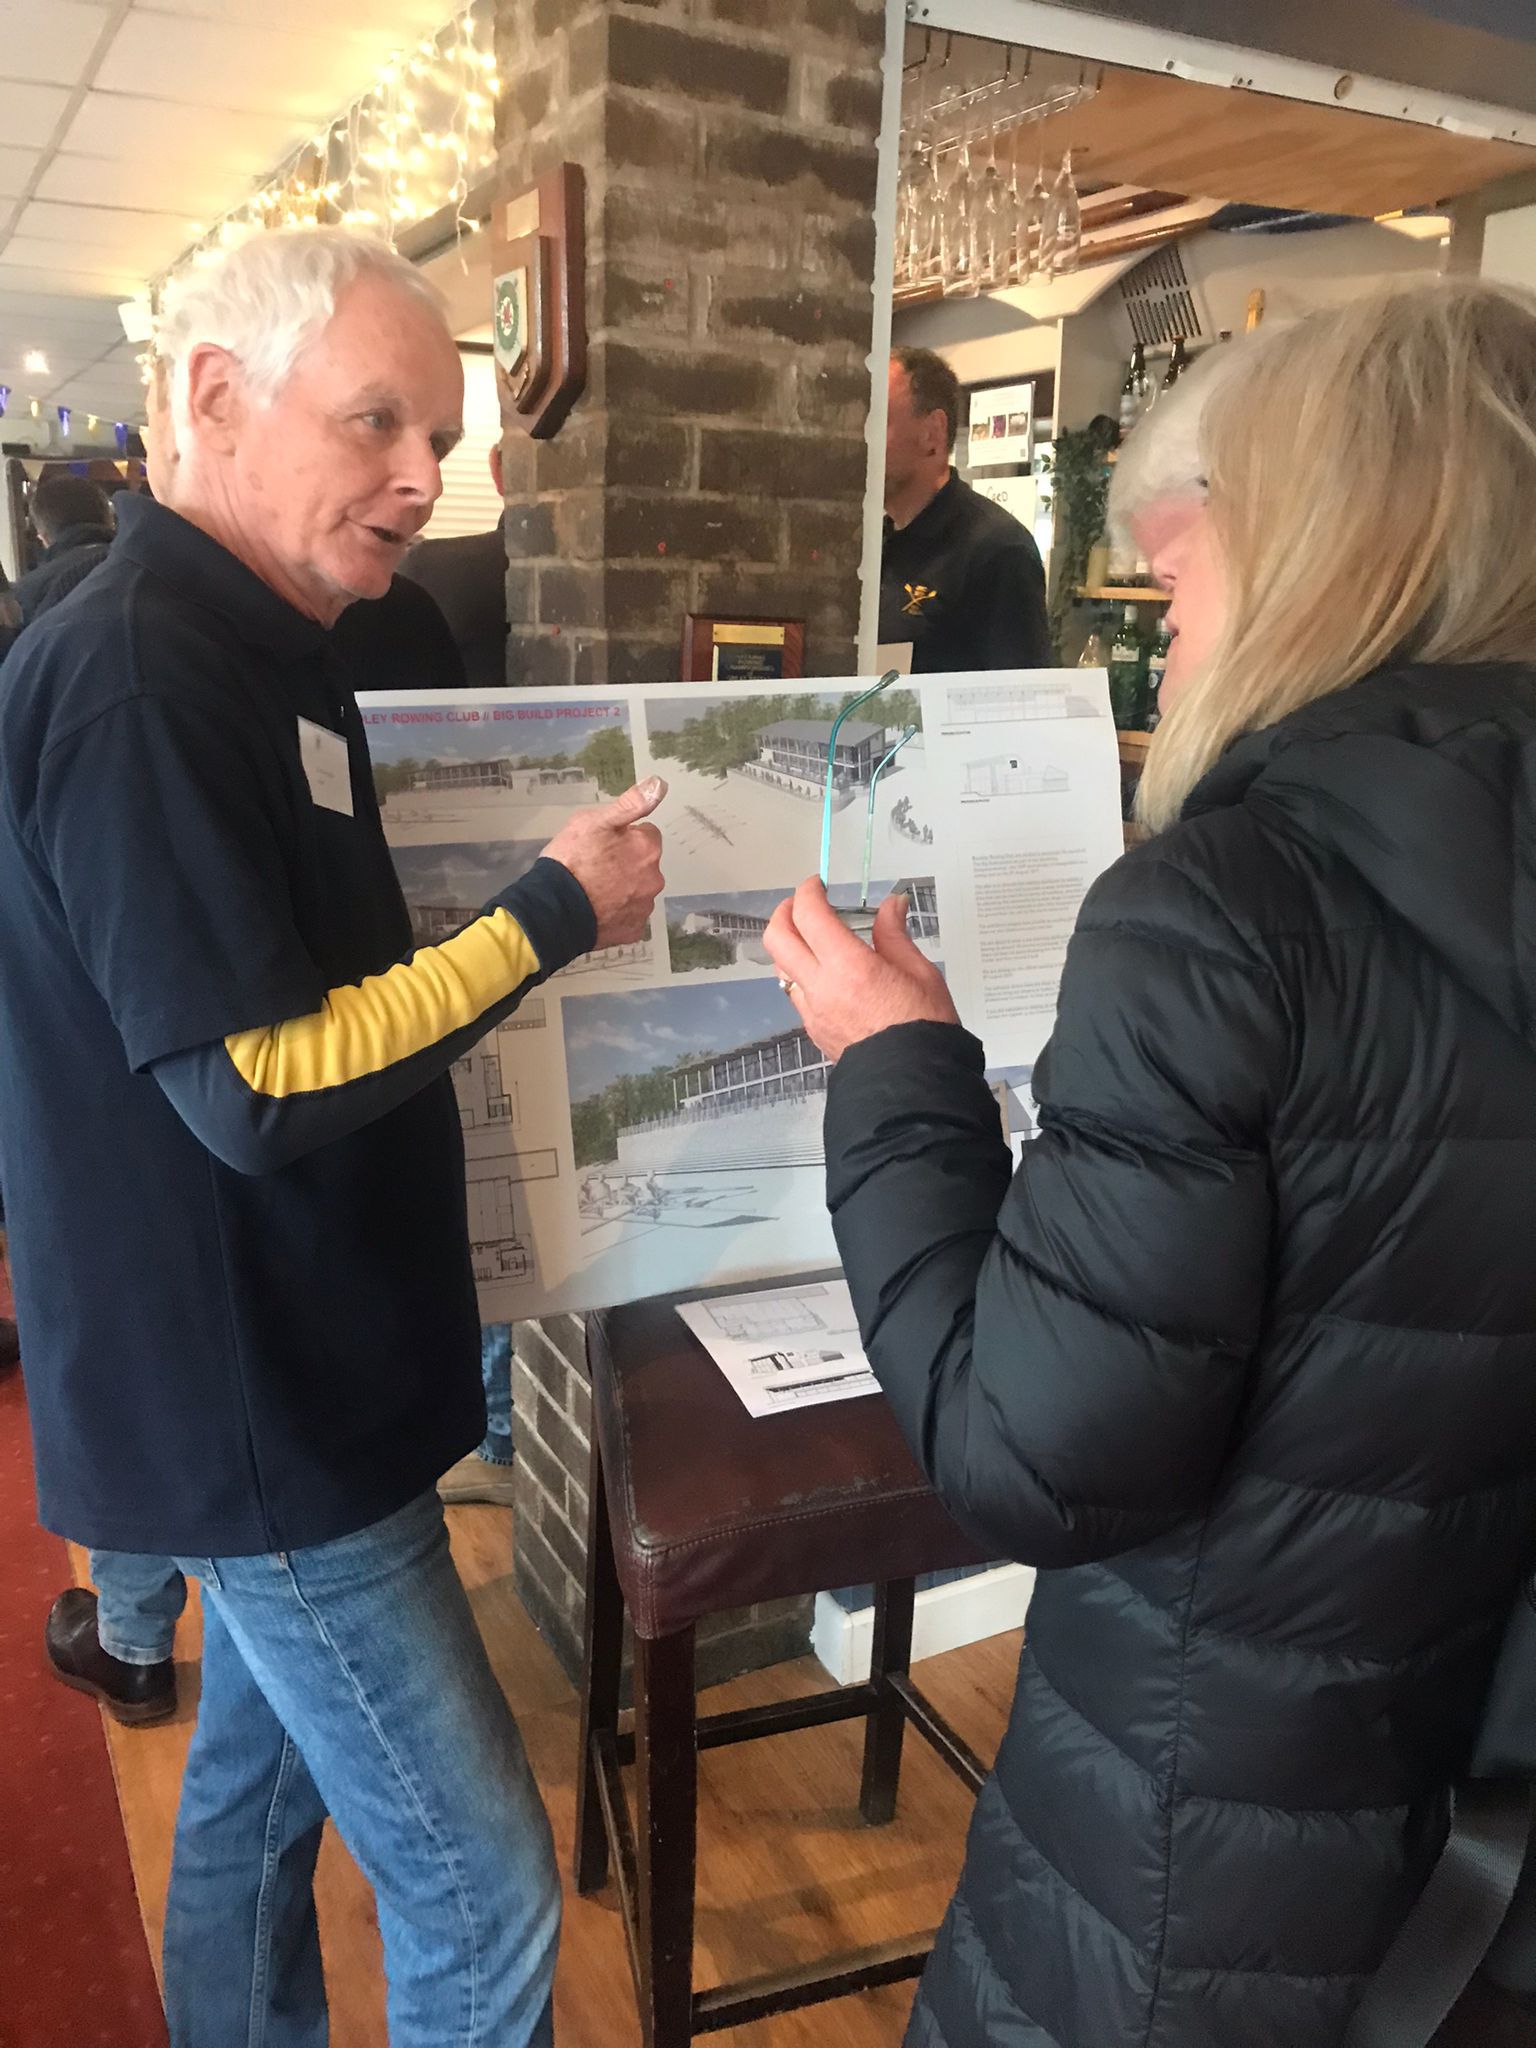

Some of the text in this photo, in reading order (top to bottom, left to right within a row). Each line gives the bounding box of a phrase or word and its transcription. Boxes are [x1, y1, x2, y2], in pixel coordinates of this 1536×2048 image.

[362, 713, 388, 725] LEY
[391, 712, 442, 724] ROWING
[446, 710, 480, 722] CLUB
[493, 709, 514, 721] BIG
[517, 708, 553, 720] BUILD
[556, 706, 610, 719] PROJECT
[613, 706, 620, 717] 2
